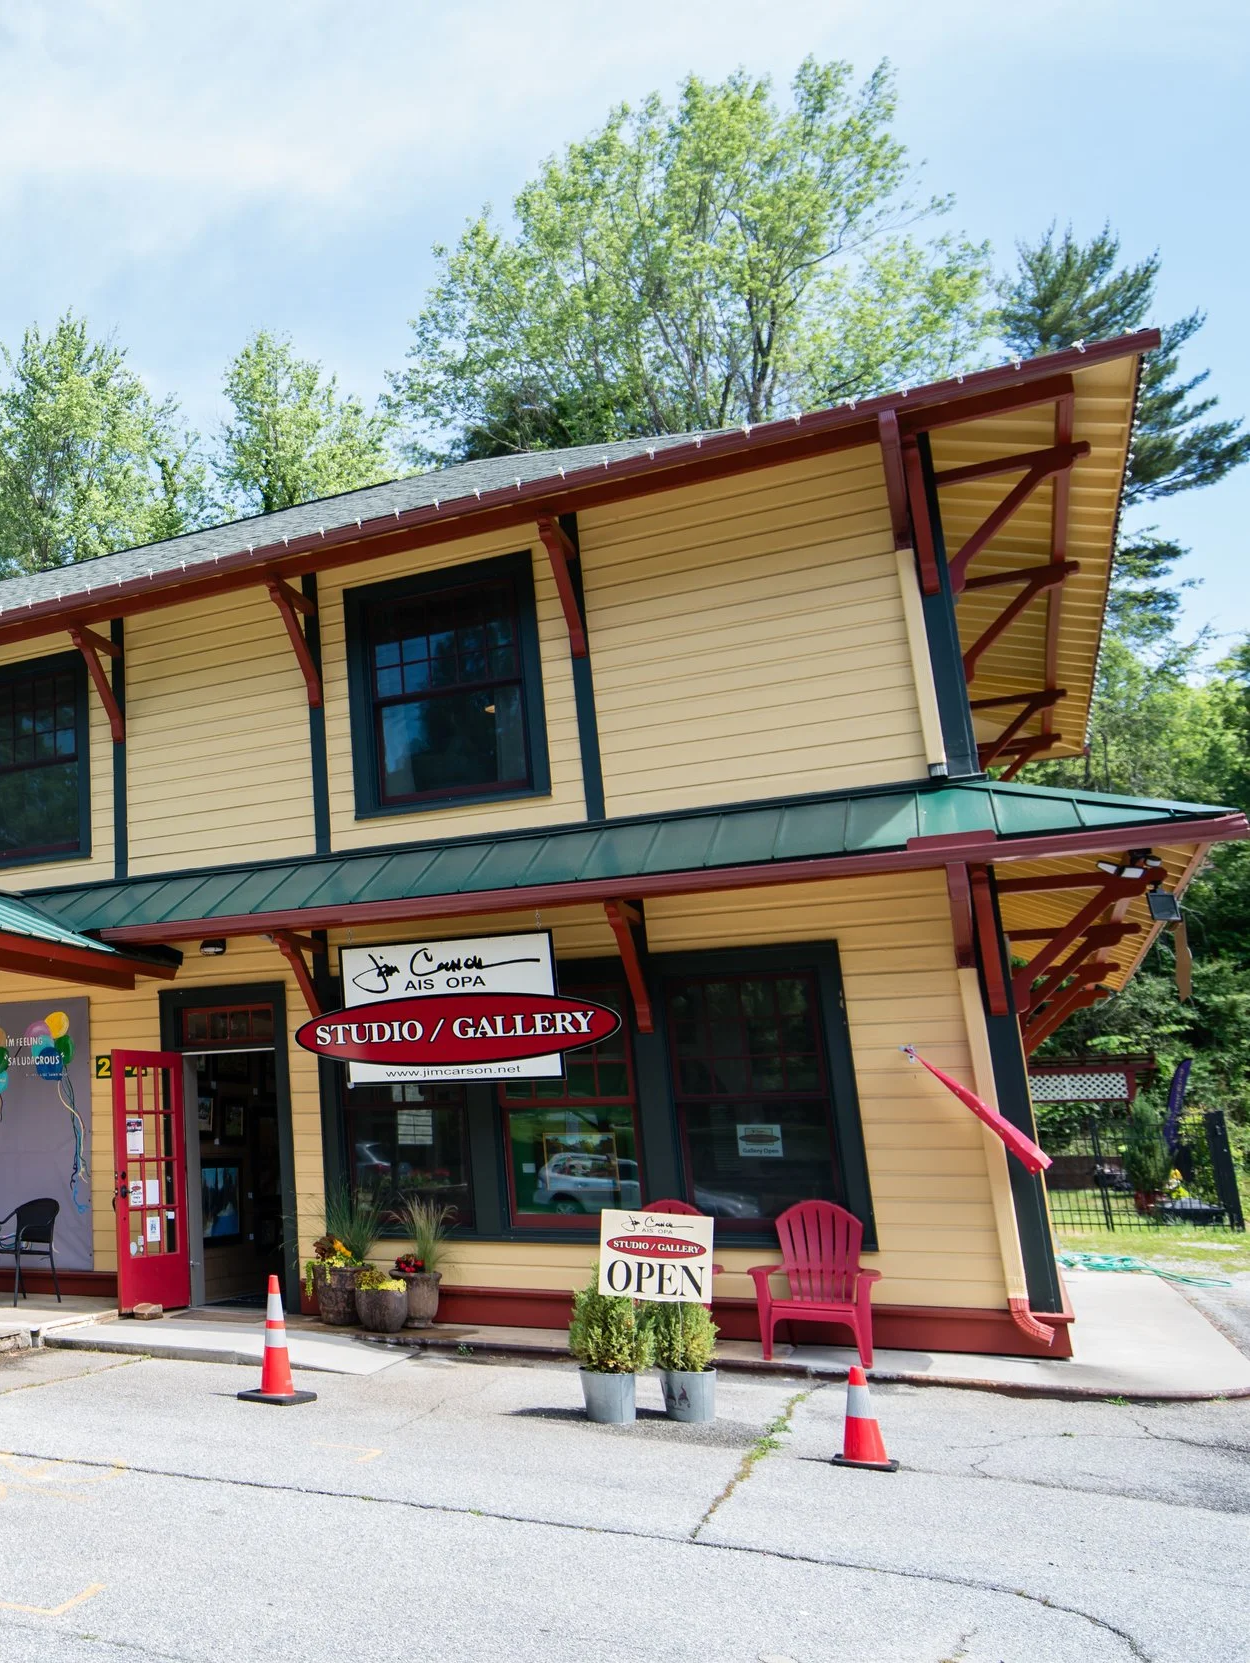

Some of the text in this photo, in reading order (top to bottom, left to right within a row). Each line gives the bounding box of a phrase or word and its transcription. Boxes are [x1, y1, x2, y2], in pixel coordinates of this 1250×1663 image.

[405, 976, 486, 991] AIS OPA
[315, 1020, 423, 1046] STUDIO
[452, 1011, 595, 1040] GALLERY
[16, 1036, 43, 1047] FEELING
[385, 1065, 521, 1079] www.jimcarson.net
[613, 1240, 649, 1250] STUDIO
[657, 1243, 700, 1254] GALLERY
[607, 1259, 705, 1298] OPEN
